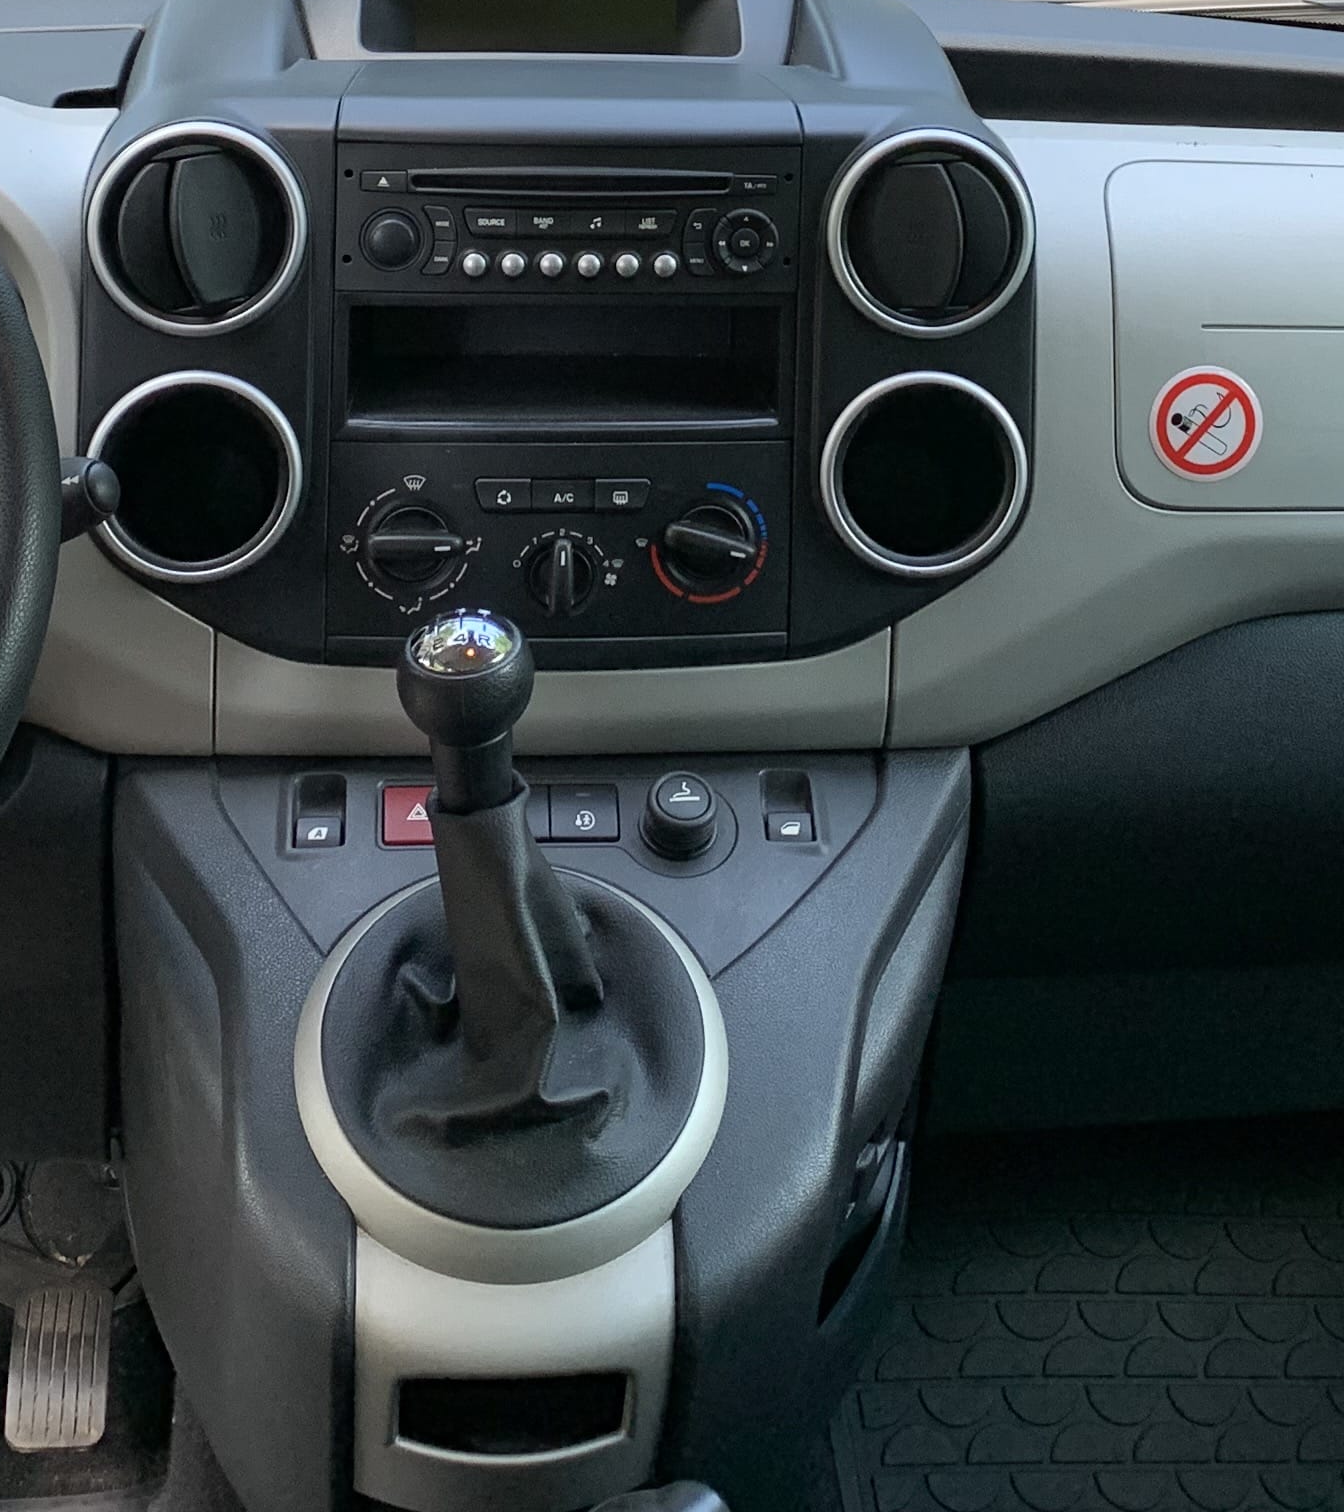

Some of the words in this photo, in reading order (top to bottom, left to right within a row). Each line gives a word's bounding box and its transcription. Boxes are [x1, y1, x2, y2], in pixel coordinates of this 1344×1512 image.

[477, 218, 505, 226] SOURCE
[533, 217, 554, 225] BAND
[641, 217, 656, 225] LIST
[554, 492, 574, 503] A/C
[559, 528, 566, 537] 2
[531, 537, 538, 545] 1
[587, 536, 594, 545] 3
[602, 559, 610, 567] 4
[453, 633, 467, 642] 4
[478, 634, 491, 646] R
[314, 829, 323, 838] A
